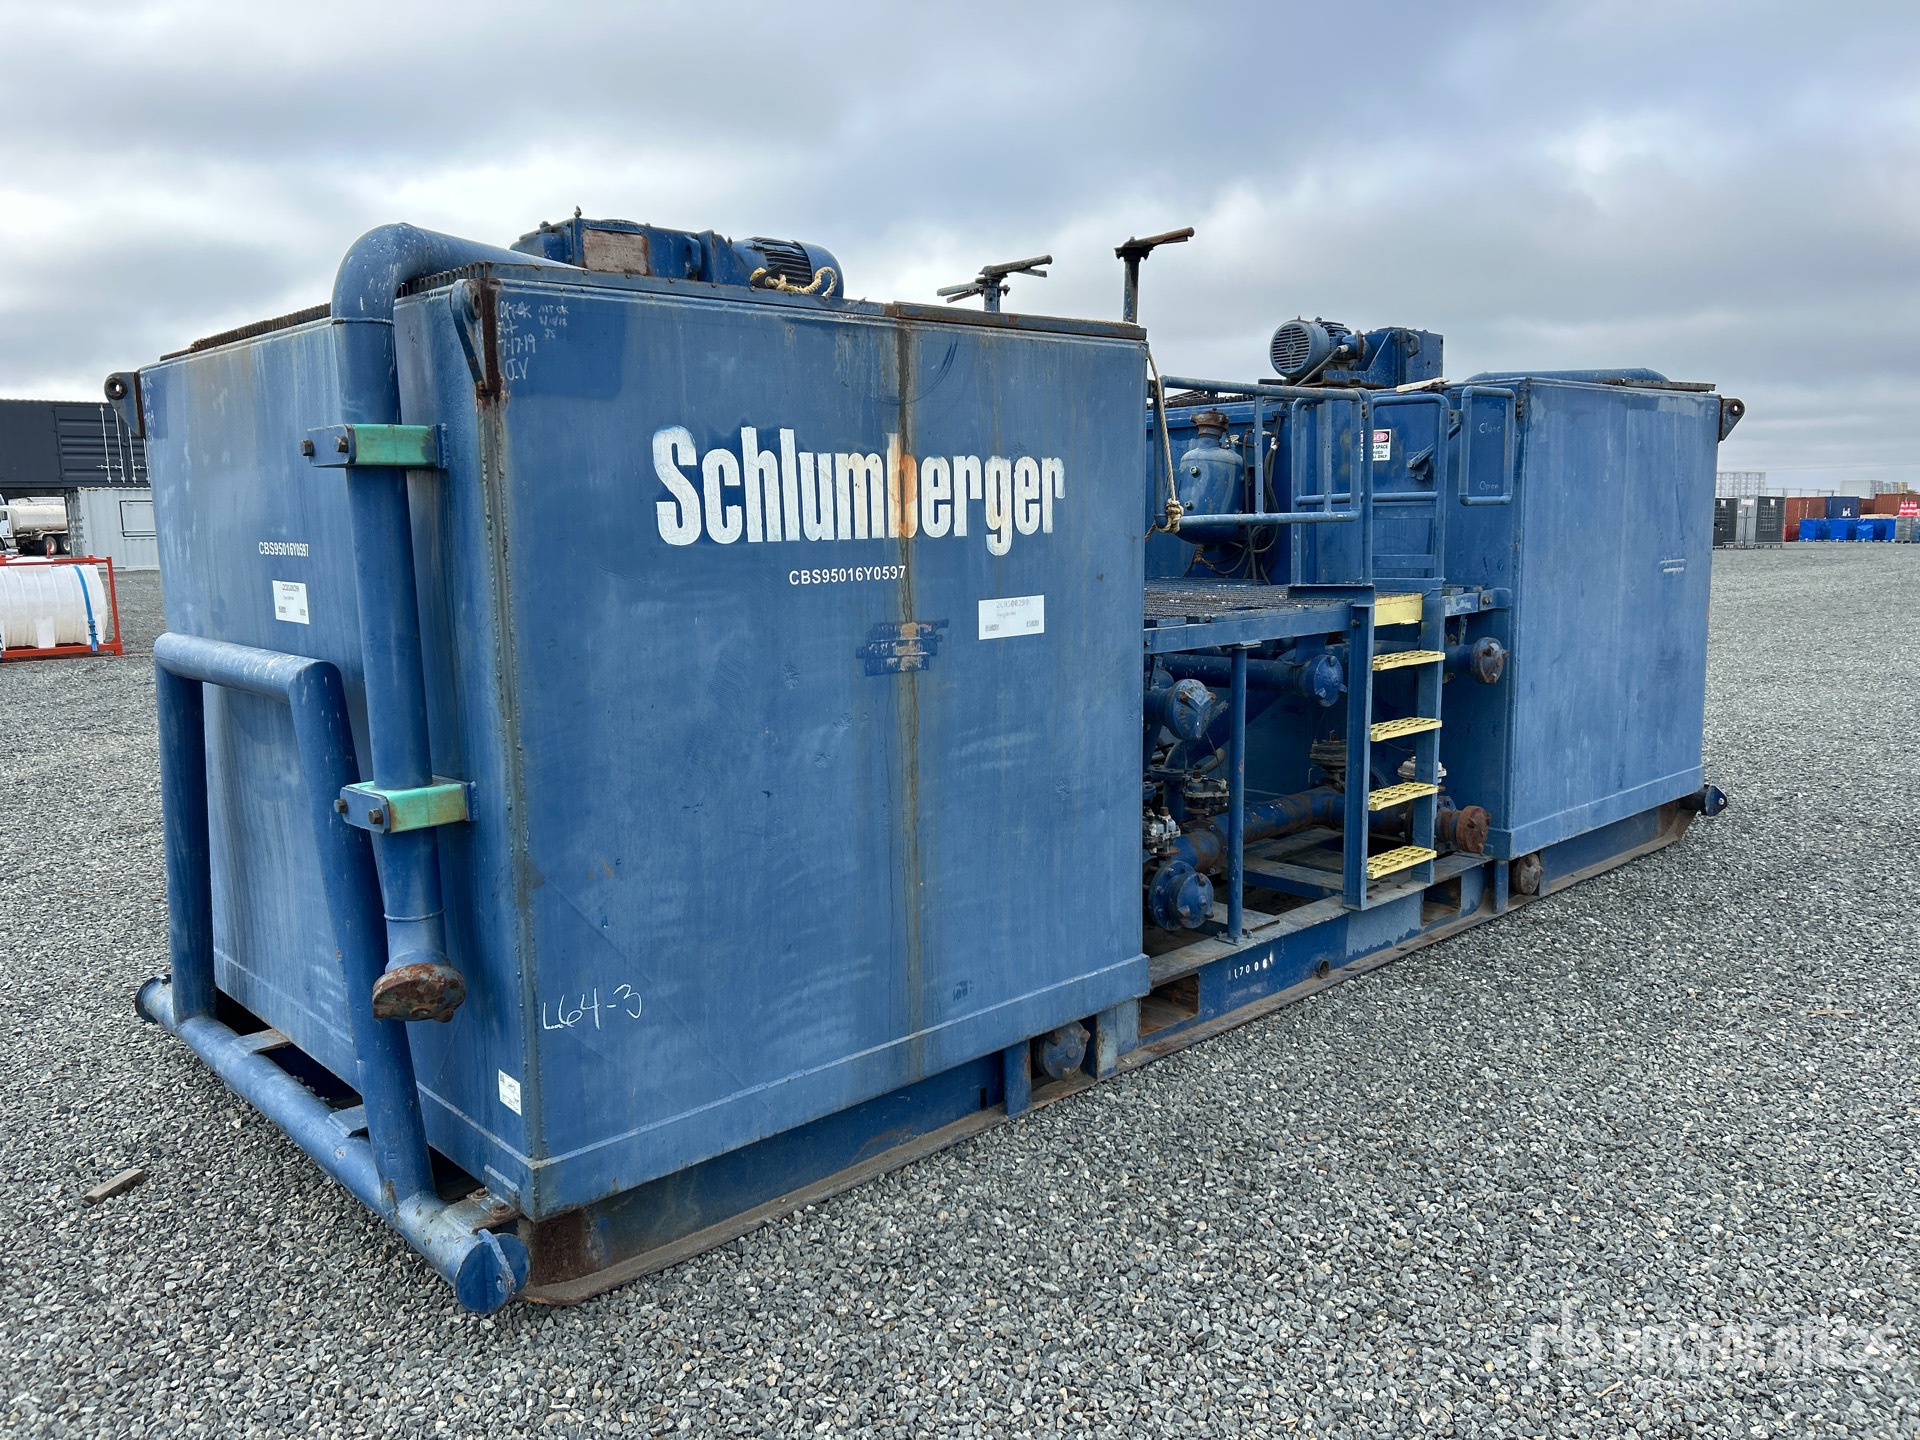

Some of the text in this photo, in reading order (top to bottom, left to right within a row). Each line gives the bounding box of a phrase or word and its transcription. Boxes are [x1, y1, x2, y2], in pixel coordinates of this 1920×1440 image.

[652, 424, 1066, 556] Schlumberger
[258, 541, 309, 557] CBS95016Y0597
[788, 565, 906, 585] CBS95016Y0597
[542, 983, 642, 1031] L64-3
